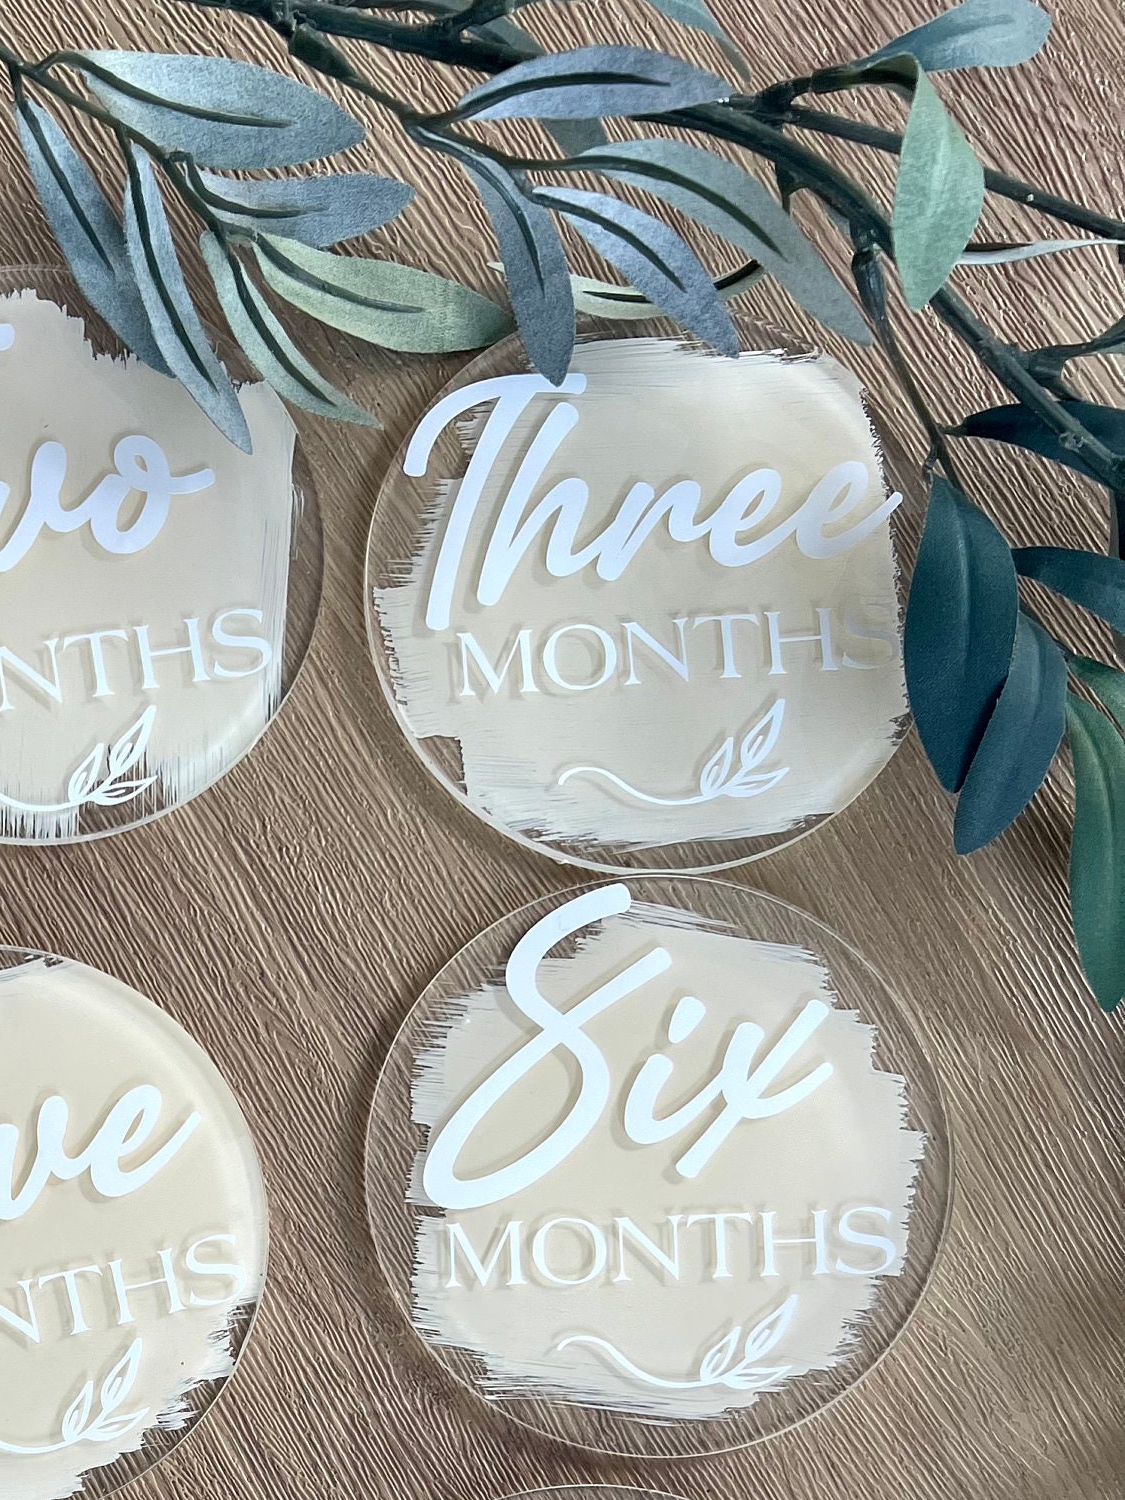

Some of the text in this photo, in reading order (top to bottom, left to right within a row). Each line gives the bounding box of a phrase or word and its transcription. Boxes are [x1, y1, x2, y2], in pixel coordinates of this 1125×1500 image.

[403, 373, 903, 630] Three
[456, 606, 901, 697] MONTHS
[423, 883, 833, 1210] Six
[444, 1206, 896, 1288] MONTHS
